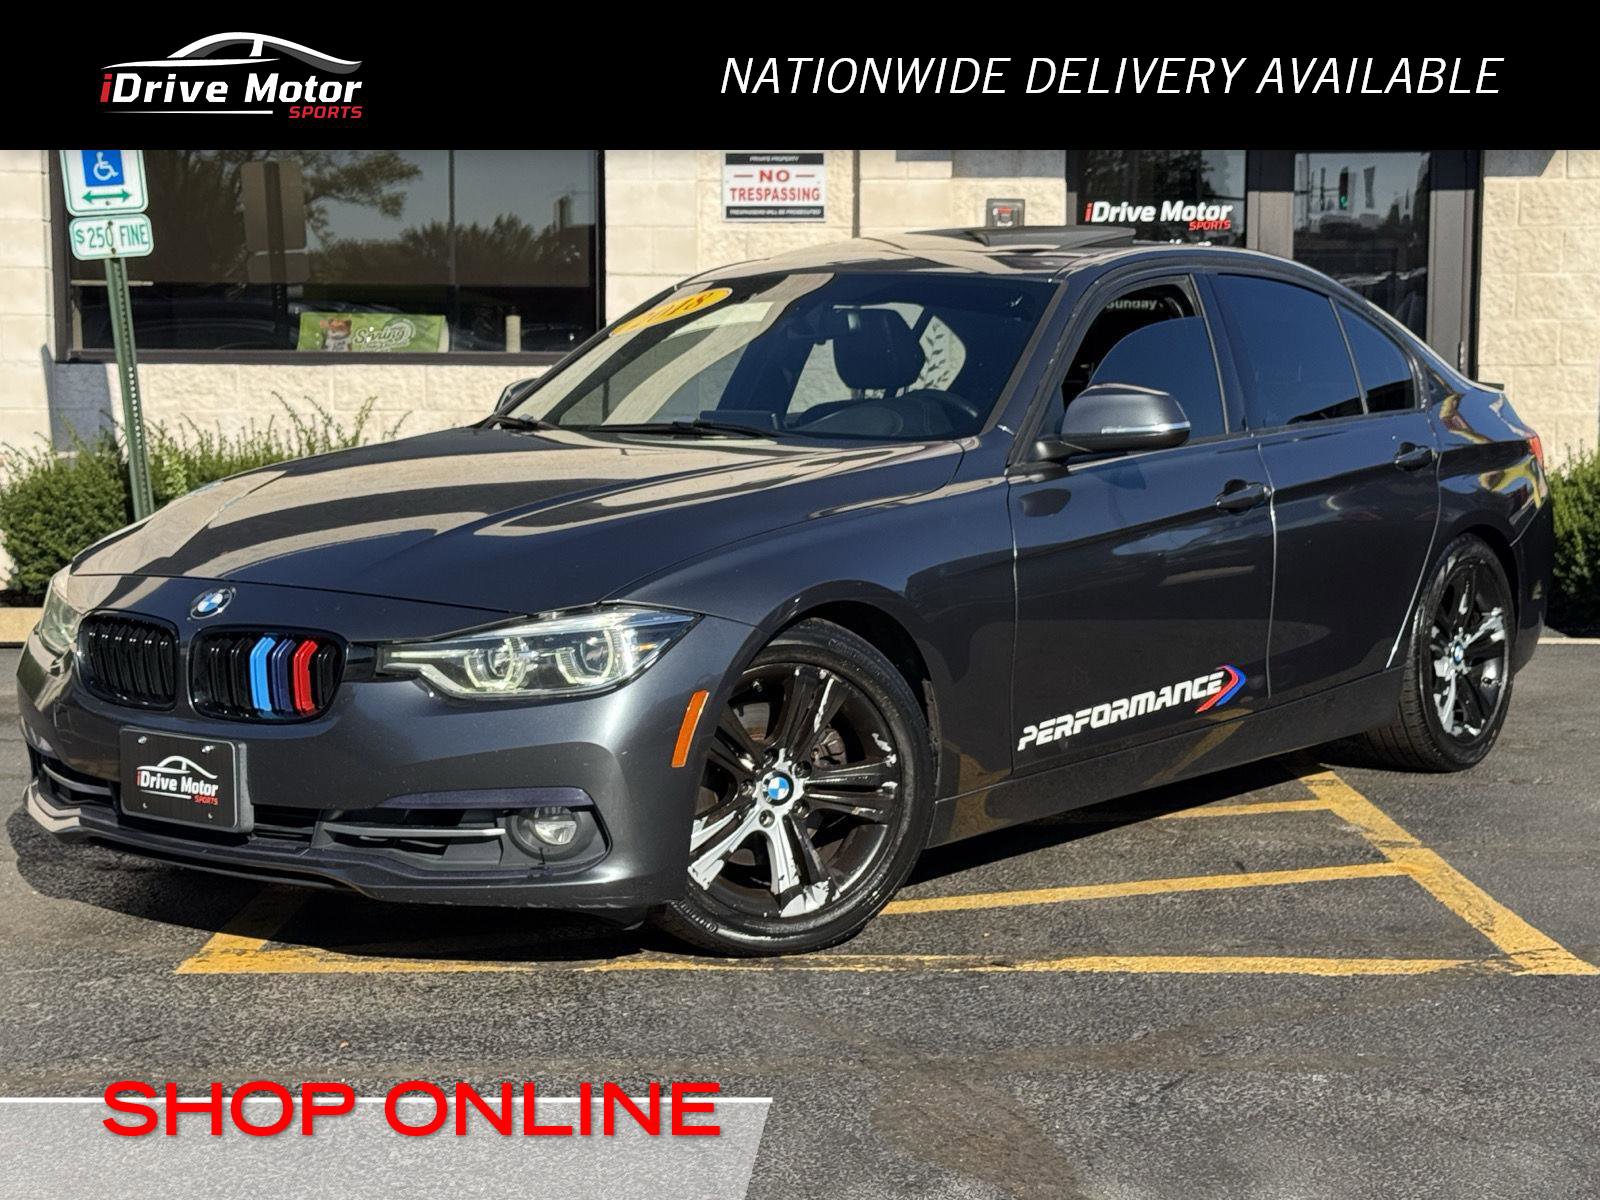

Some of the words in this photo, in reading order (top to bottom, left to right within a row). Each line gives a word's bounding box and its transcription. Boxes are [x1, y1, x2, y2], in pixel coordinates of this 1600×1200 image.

[759, 170, 791, 182] NO
[730, 187, 820, 201] TRESPASSING
[1085, 201, 1156, 223] iDrive
[1160, 201, 1233, 222] Motor
[1188, 219, 1231, 231] SPORTS
[120, 224, 148, 247] FINE
[1018, 671, 1224, 751] PERFORMANCE
[137, 770, 178, 792] iDrive
[181, 776, 218, 797] Motor
[194, 795, 218, 805] SPORTS
